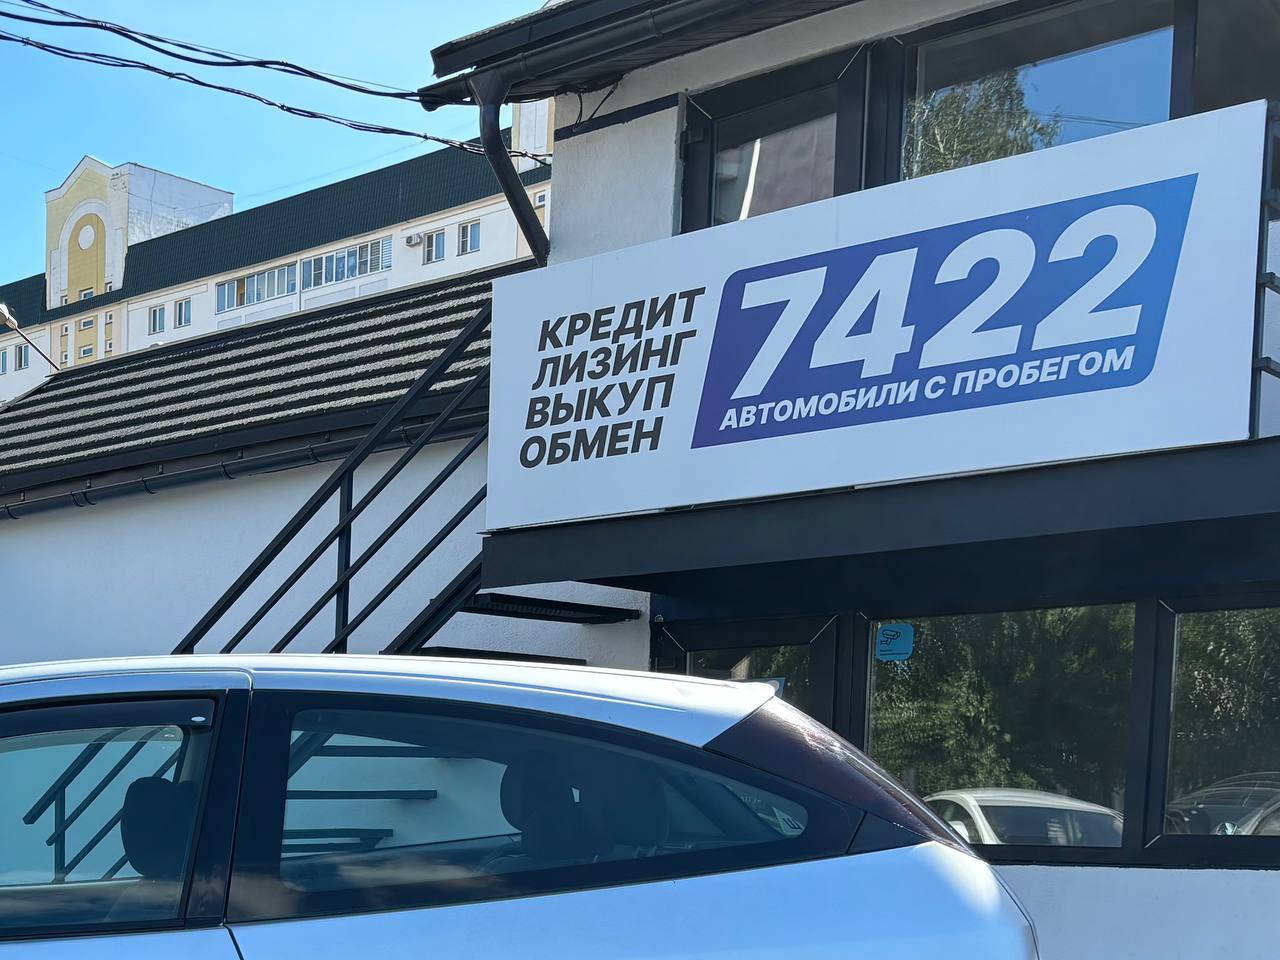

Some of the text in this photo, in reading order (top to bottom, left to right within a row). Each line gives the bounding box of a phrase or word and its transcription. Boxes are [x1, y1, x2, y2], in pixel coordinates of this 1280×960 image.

[538, 287, 706, 351] КРЕДИТ
[730, 204, 1157, 400] 7422
[532, 330, 697, 390] ЛИЗИНГ
[719, 345, 1135, 430] АВТОМОБИЛИ С ПРОБЕГОМ
[525, 373, 675, 430] ВЫКУП
[520, 416, 664, 469] ОБМЕН
